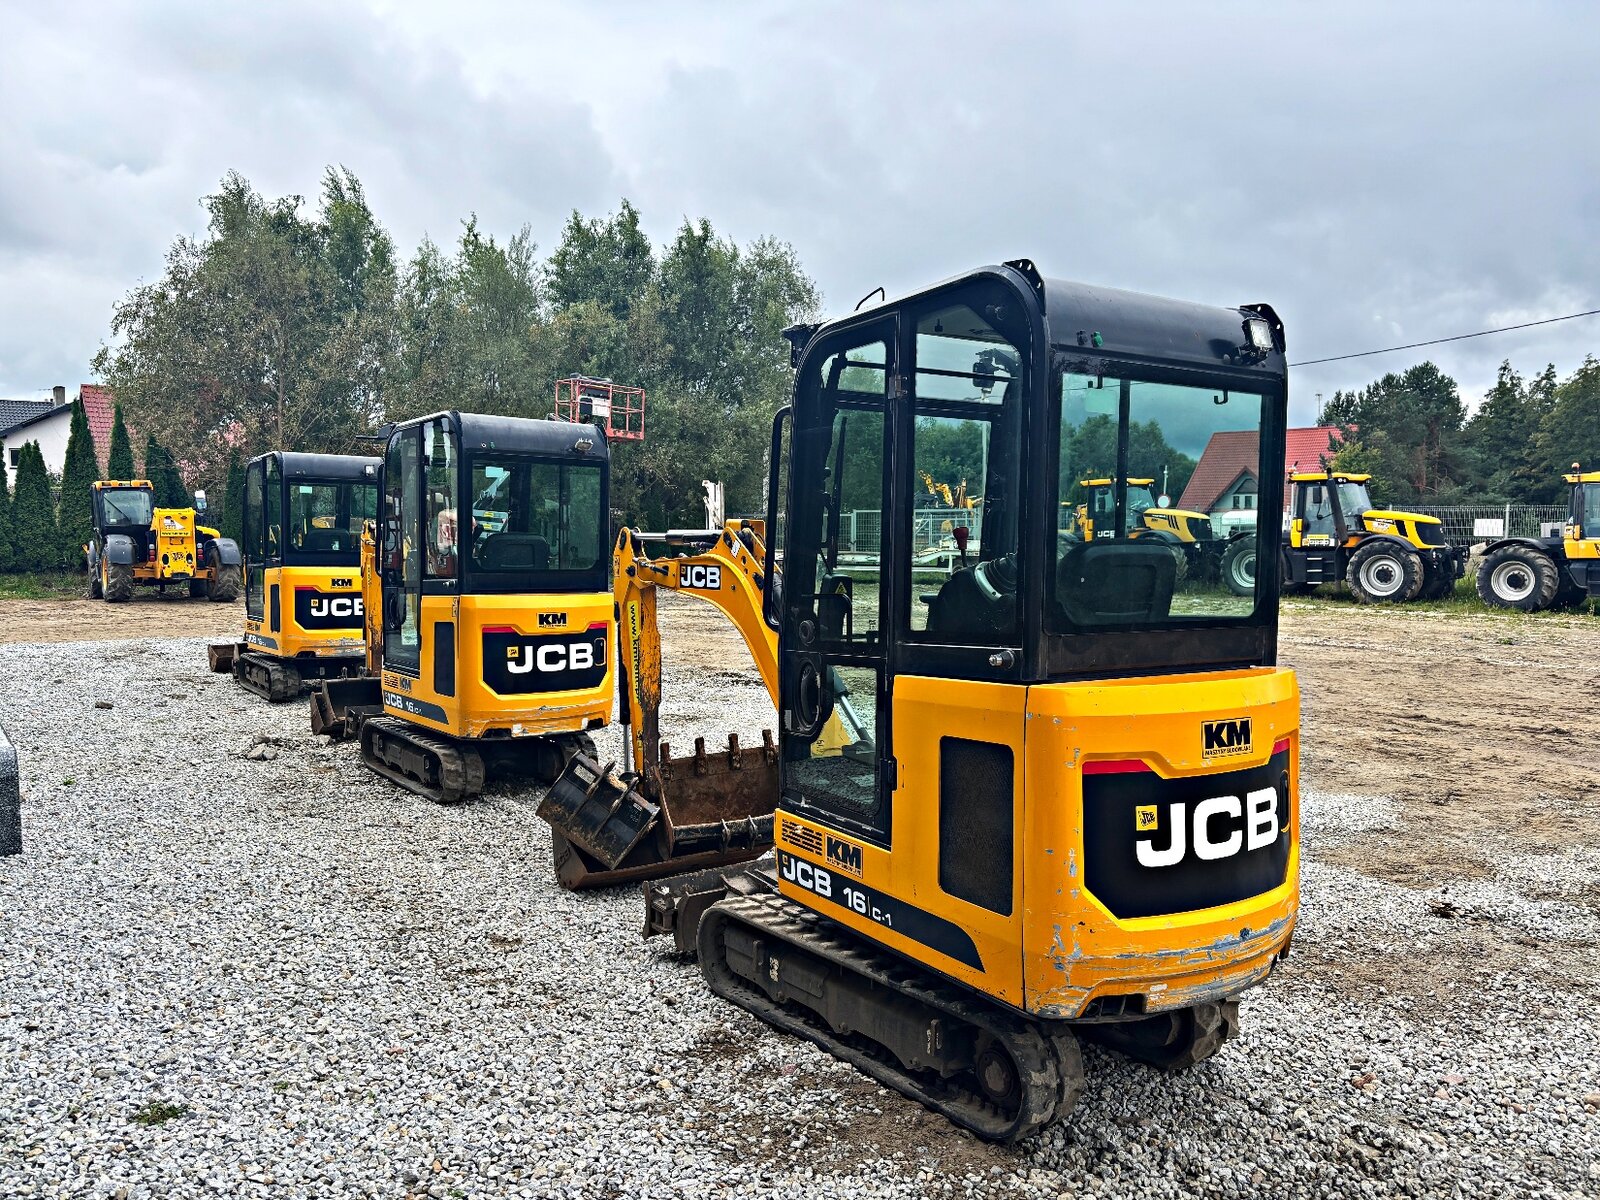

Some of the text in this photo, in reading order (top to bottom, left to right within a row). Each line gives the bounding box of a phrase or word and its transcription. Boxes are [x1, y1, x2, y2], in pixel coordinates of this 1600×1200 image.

[331, 579, 352, 587] KM
[681, 565, 720, 588] JCB
[538, 613, 567, 625] KM
[507, 642, 594, 674] JCB
[385, 692, 403, 709] JCB
[1204, 719, 1251, 749] KM
[1136, 787, 1279, 868] JCB
[826, 836, 862, 868] KM
[783, 858, 832, 897] JCB
